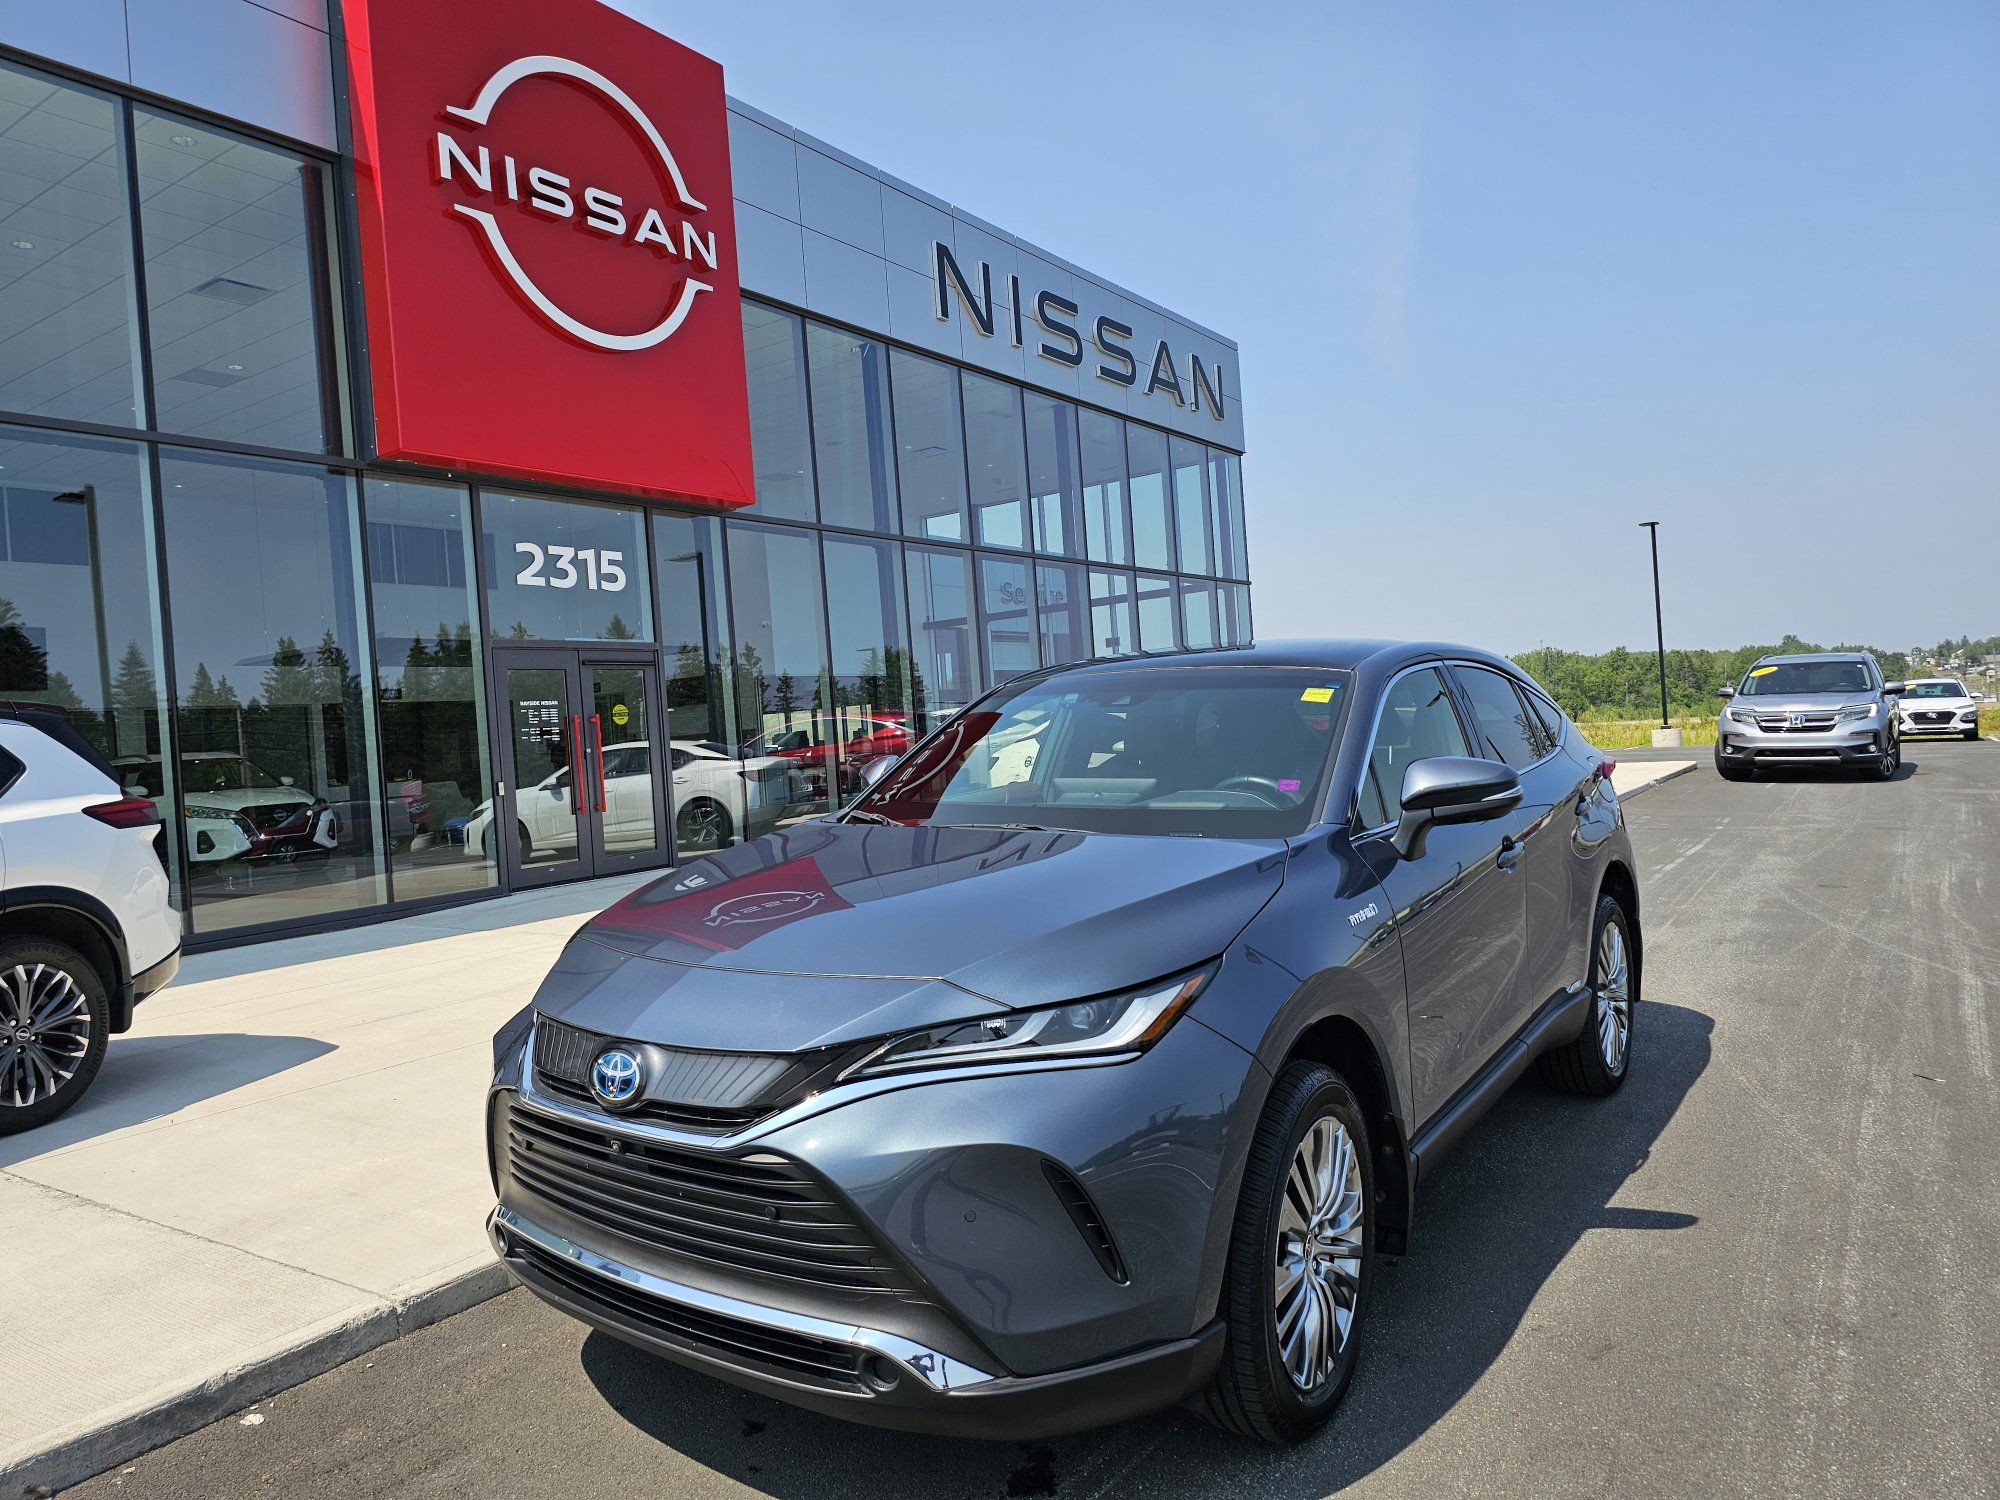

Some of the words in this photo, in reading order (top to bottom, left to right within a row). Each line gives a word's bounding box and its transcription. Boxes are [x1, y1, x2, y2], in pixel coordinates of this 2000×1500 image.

[436, 131, 718, 271] NISSAN
[931, 240, 1226, 421] NISSAN
[515, 541, 627, 592] 2315
